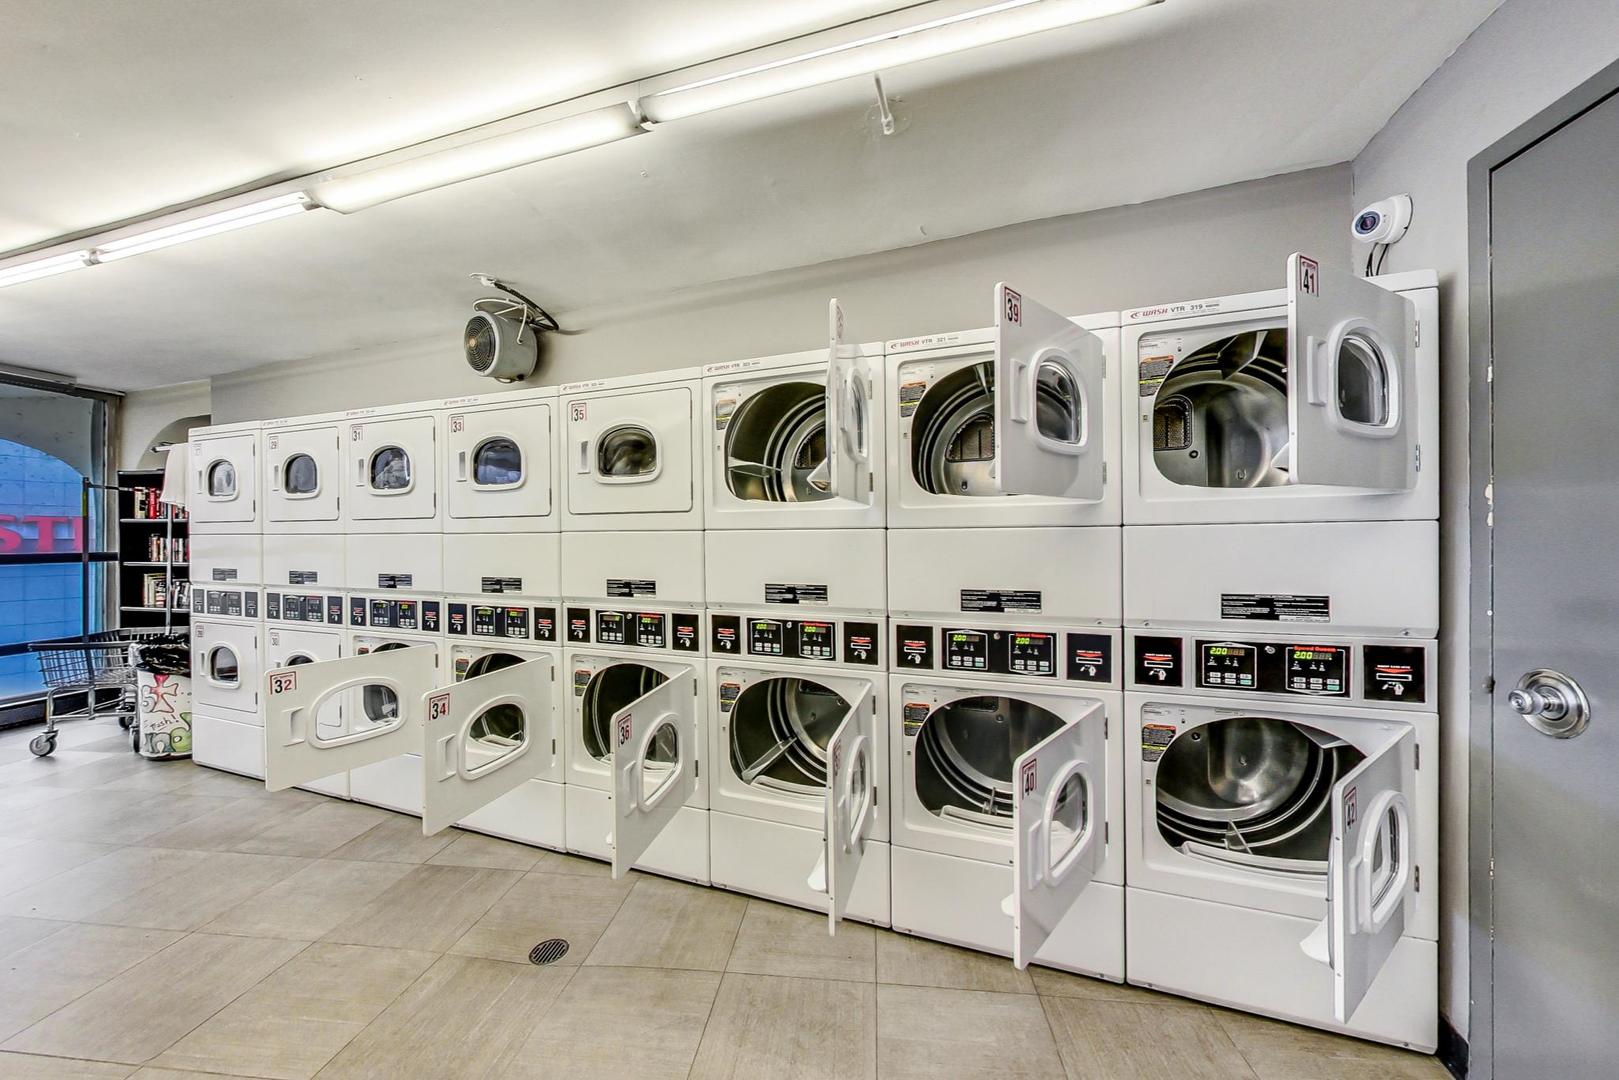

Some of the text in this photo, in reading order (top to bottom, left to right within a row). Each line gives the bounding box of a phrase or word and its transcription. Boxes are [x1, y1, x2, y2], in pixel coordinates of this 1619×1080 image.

[1303, 268, 1315, 294] 41
[1007, 297, 1019, 323] 39
[1170, 305, 1186, 313] VTR
[573, 408, 585, 422] 35
[353, 430, 361, 441] 31
[452, 420, 462, 433] 33
[274, 679, 292, 694] 32
[431, 702, 447, 720] 34
[620, 725, 630, 745] 36
[1024, 772, 1035, 796] 40
[1346, 802, 1355, 830] 42
